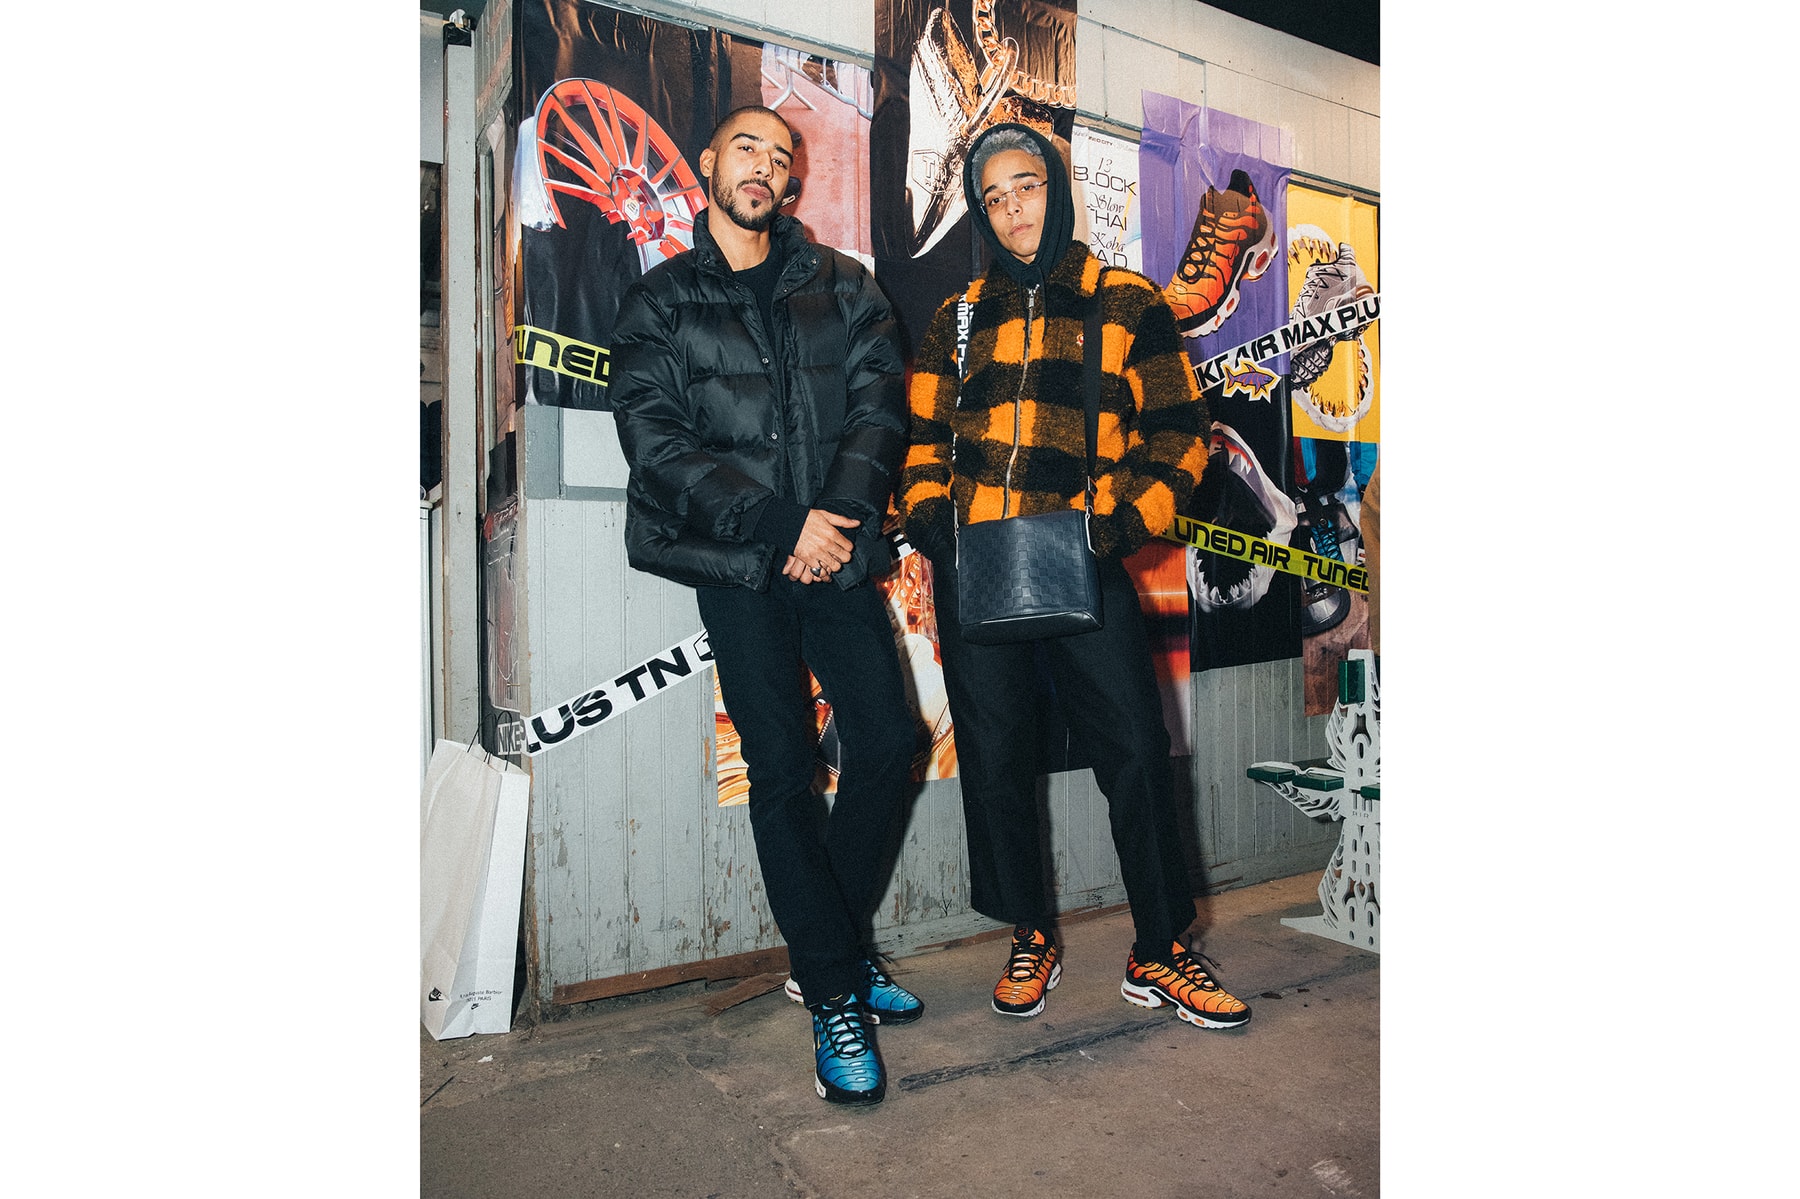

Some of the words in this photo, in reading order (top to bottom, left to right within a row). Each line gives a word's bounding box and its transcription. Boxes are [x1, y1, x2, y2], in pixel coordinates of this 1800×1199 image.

[1098, 157, 1113, 173] 13
[1089, 191, 1125, 214] Slow
[1090, 231, 1126, 252] Koba
[1088, 245, 1128, 268] AD
[1280, 312, 1337, 349] MAX
[1337, 296, 1380, 330] PLU
[1163, 517, 1247, 559] UNED
[1249, 540, 1291, 570] AIR
[614, 645, 692, 702] TN
